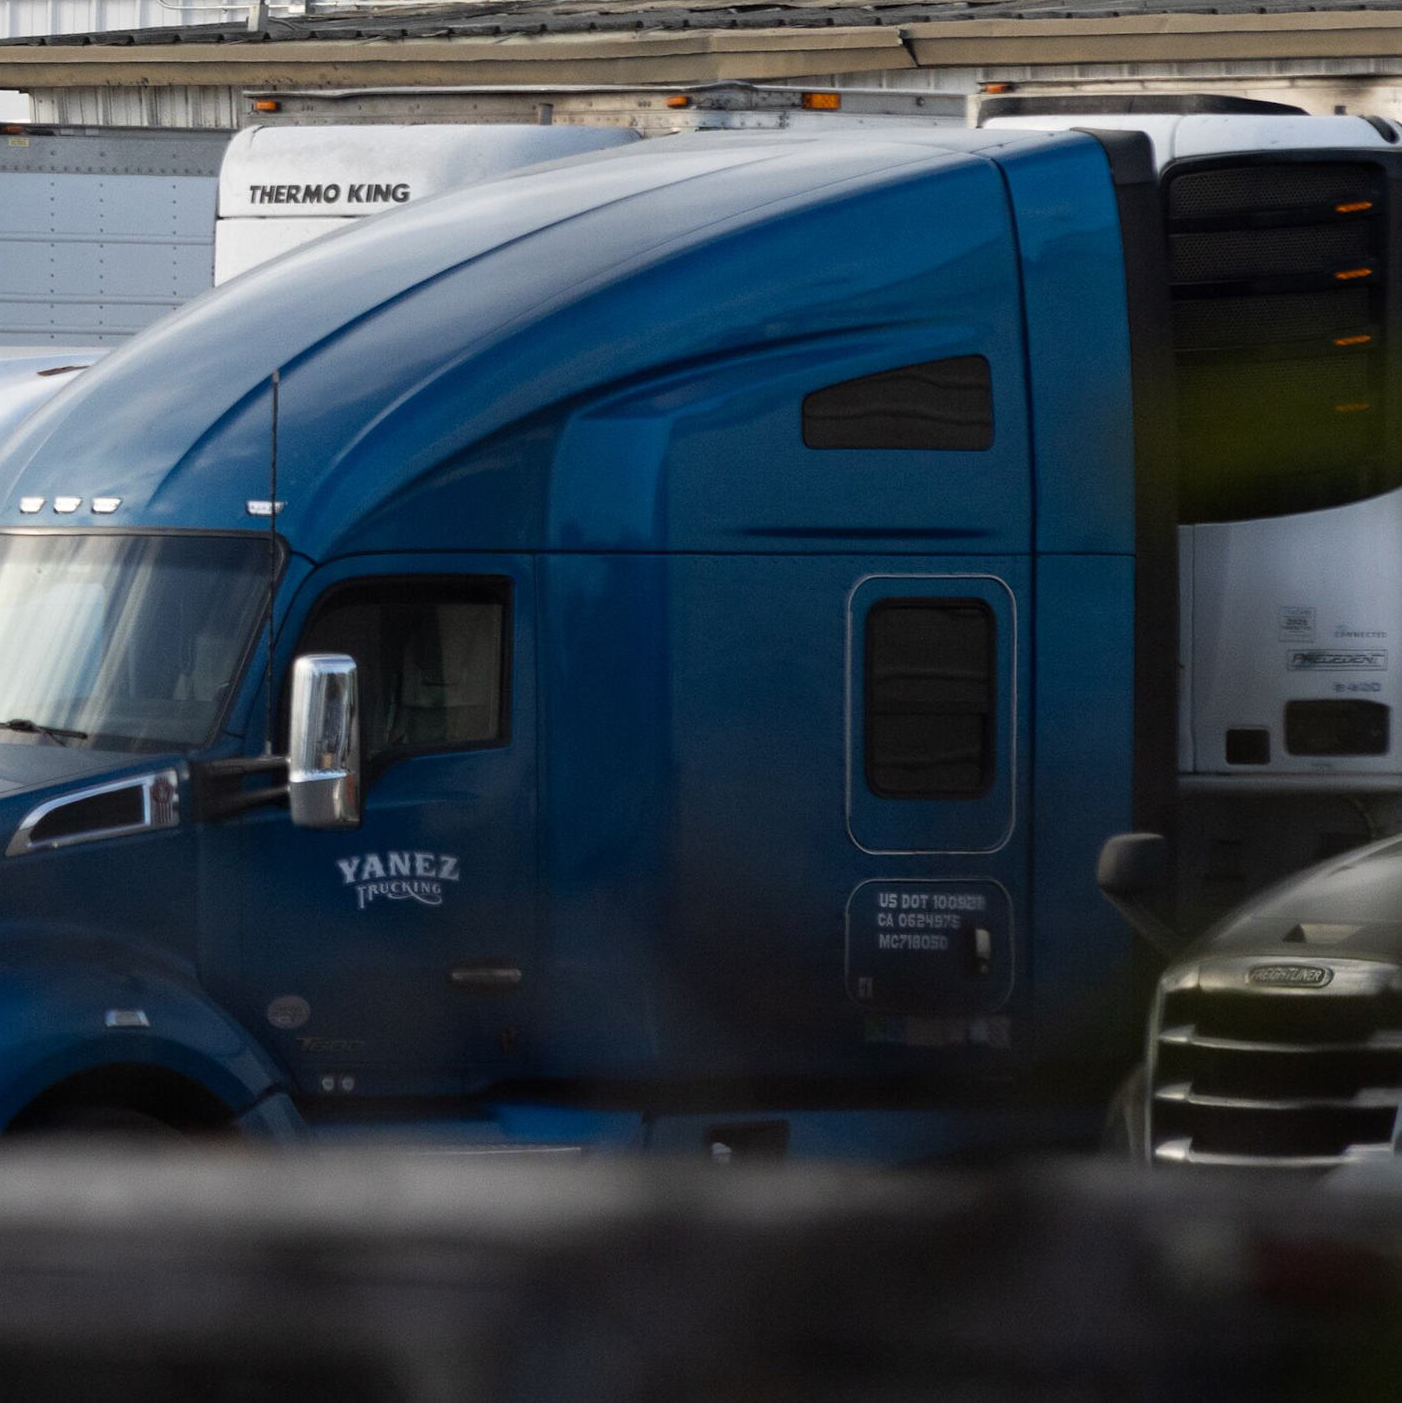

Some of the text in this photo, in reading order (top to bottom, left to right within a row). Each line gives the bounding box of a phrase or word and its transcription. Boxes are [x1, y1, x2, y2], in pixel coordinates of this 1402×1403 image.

[250, 183, 410, 204] THERMO KING
[337, 850, 460, 885] YANEZ
[356, 881, 443, 910] TRUCKING
[879, 893, 898, 909] US
[901, 894, 929, 910] DOT
[877, 913, 894, 928] CA
